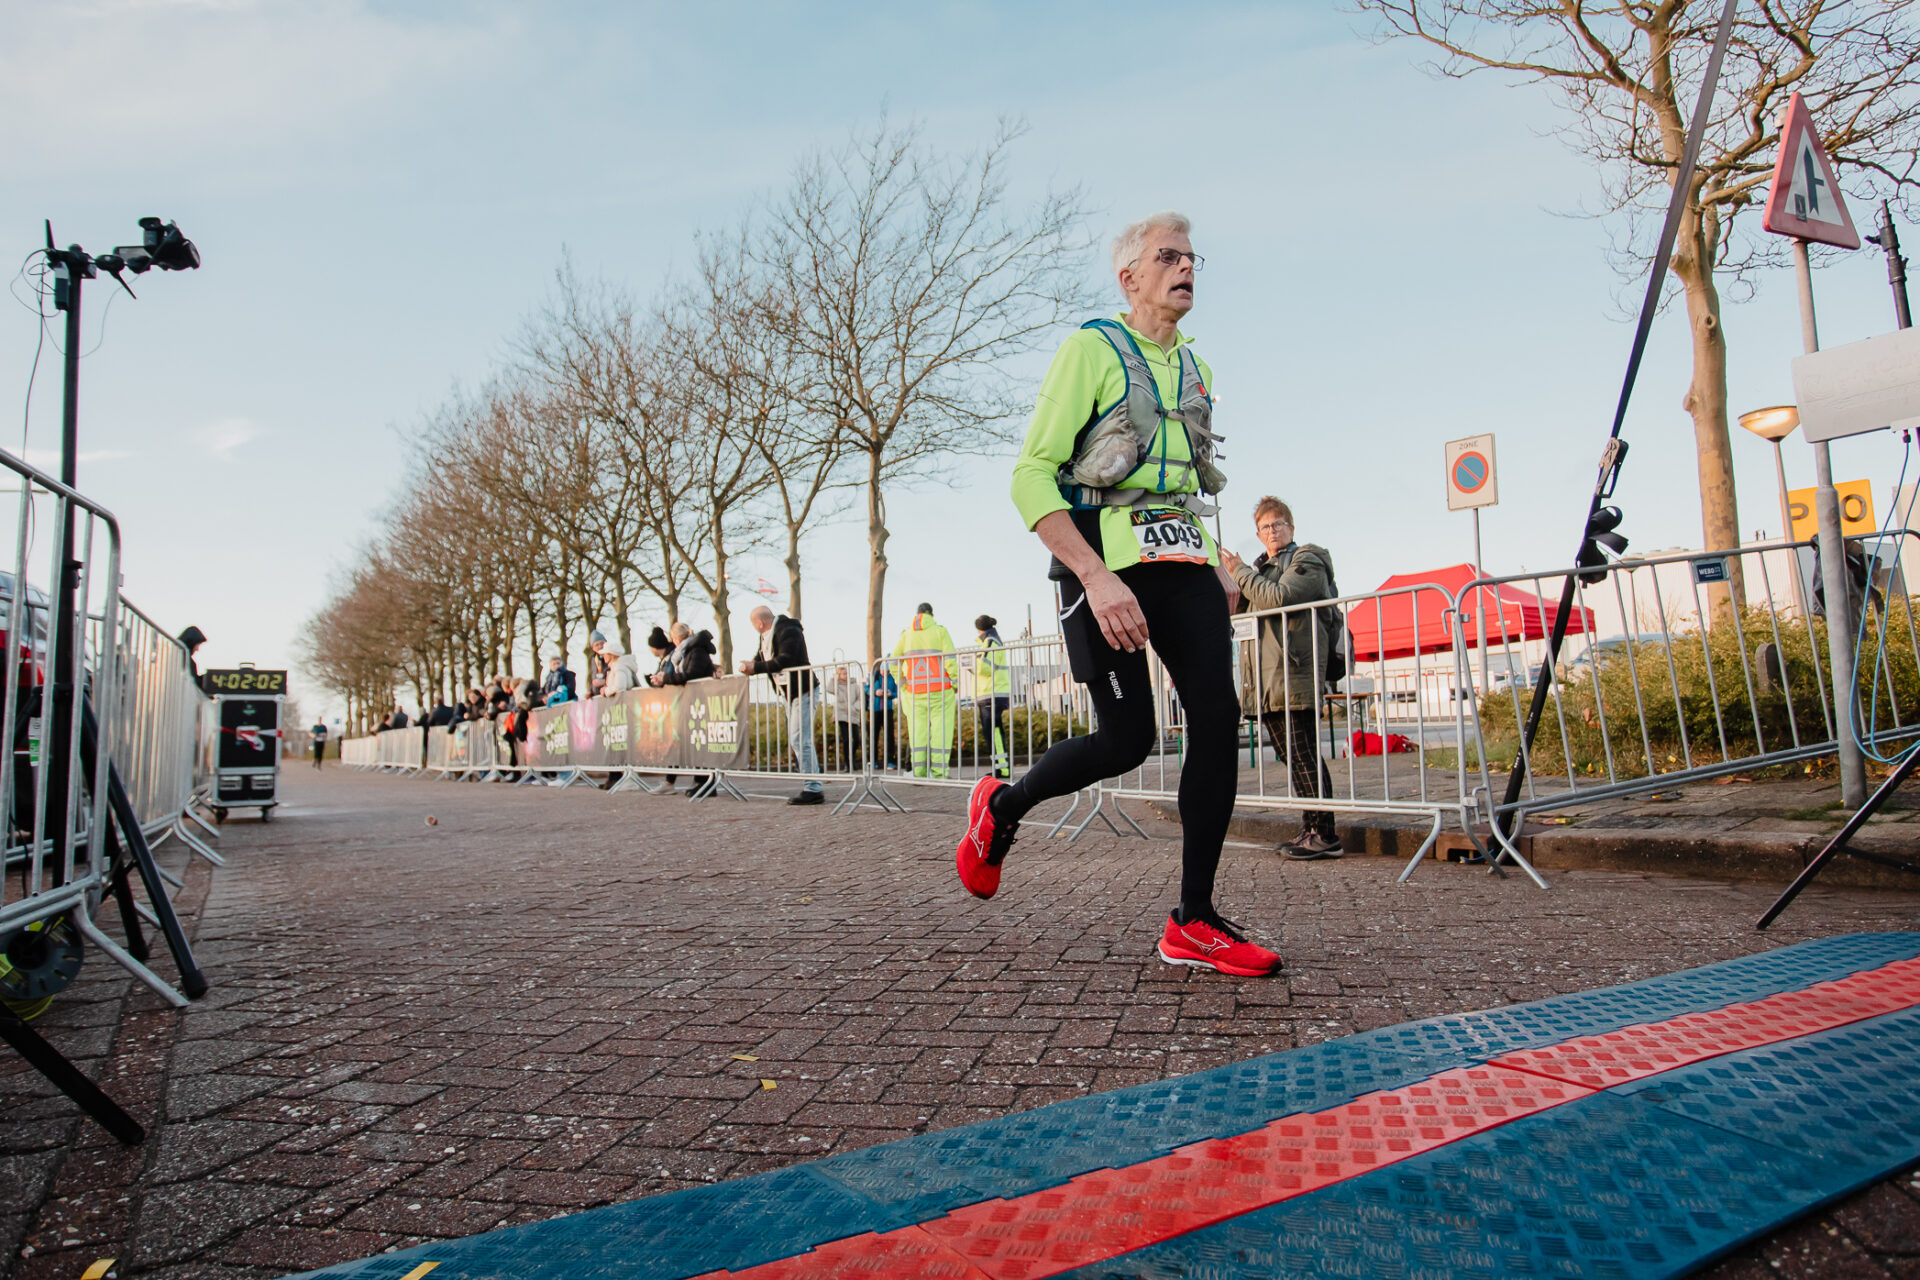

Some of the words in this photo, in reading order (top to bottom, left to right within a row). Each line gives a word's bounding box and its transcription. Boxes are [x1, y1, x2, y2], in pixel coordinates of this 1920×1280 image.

[1457, 440, 1479, 450] ZONE
[1143, 522, 1203, 550] 4049
[1698, 567, 1715, 575] WEBO
[211, 673, 283, 690] 4:02:02
[1107, 670, 1124, 700] FUSION
[707, 694, 738, 721] VALK
[707, 721, 739, 743] EVENT
